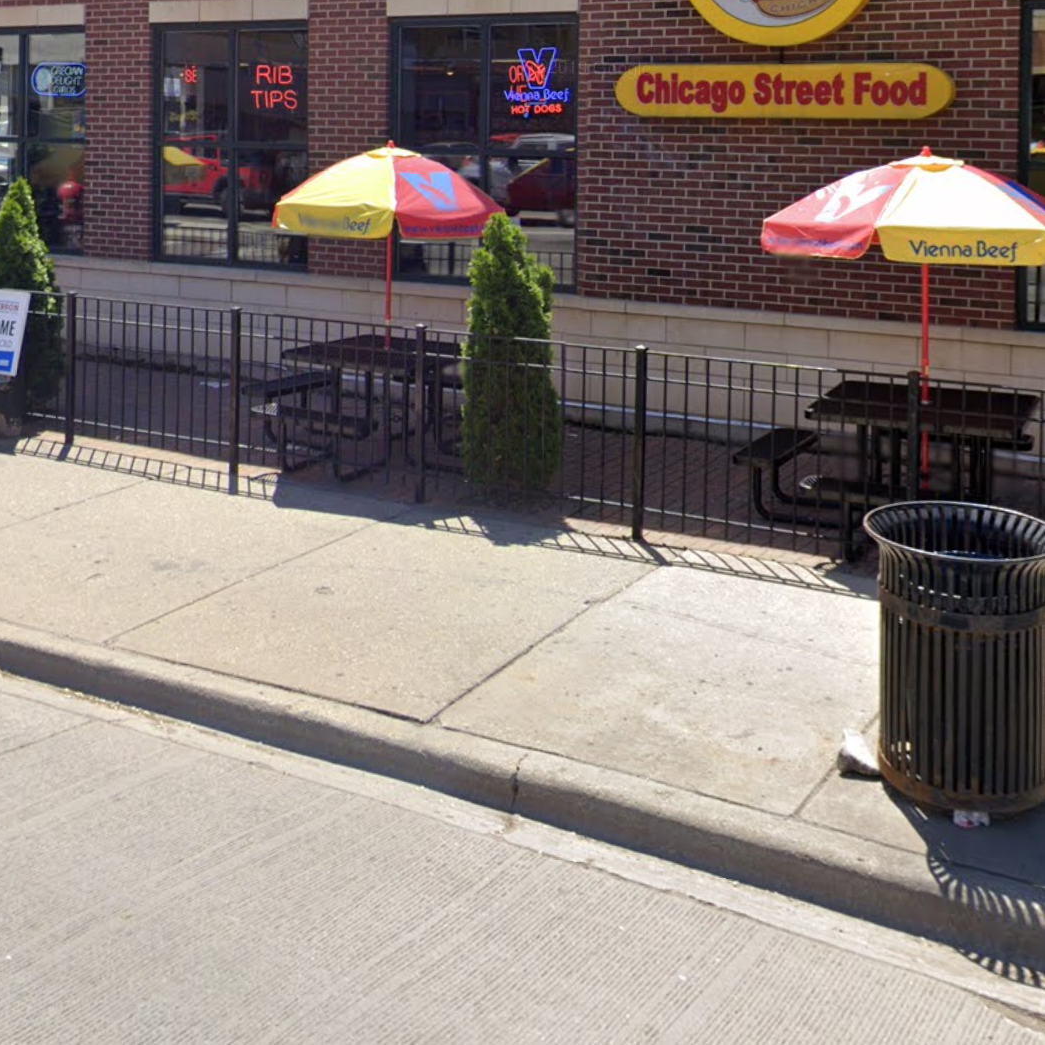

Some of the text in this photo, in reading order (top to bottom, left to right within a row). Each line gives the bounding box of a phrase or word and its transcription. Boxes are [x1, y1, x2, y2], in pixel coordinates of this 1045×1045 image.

[255, 65, 293, 85] RIB
[250, 90, 298, 110] TIPS
[504, 88, 570, 103] Vienna Beef
[636, 72, 927, 113] Chicago Street Food
[511, 103, 563, 114] HOT DOGS
[343, 216, 371, 235] Beef
[908, 240, 1018, 262] Vienna Beef
